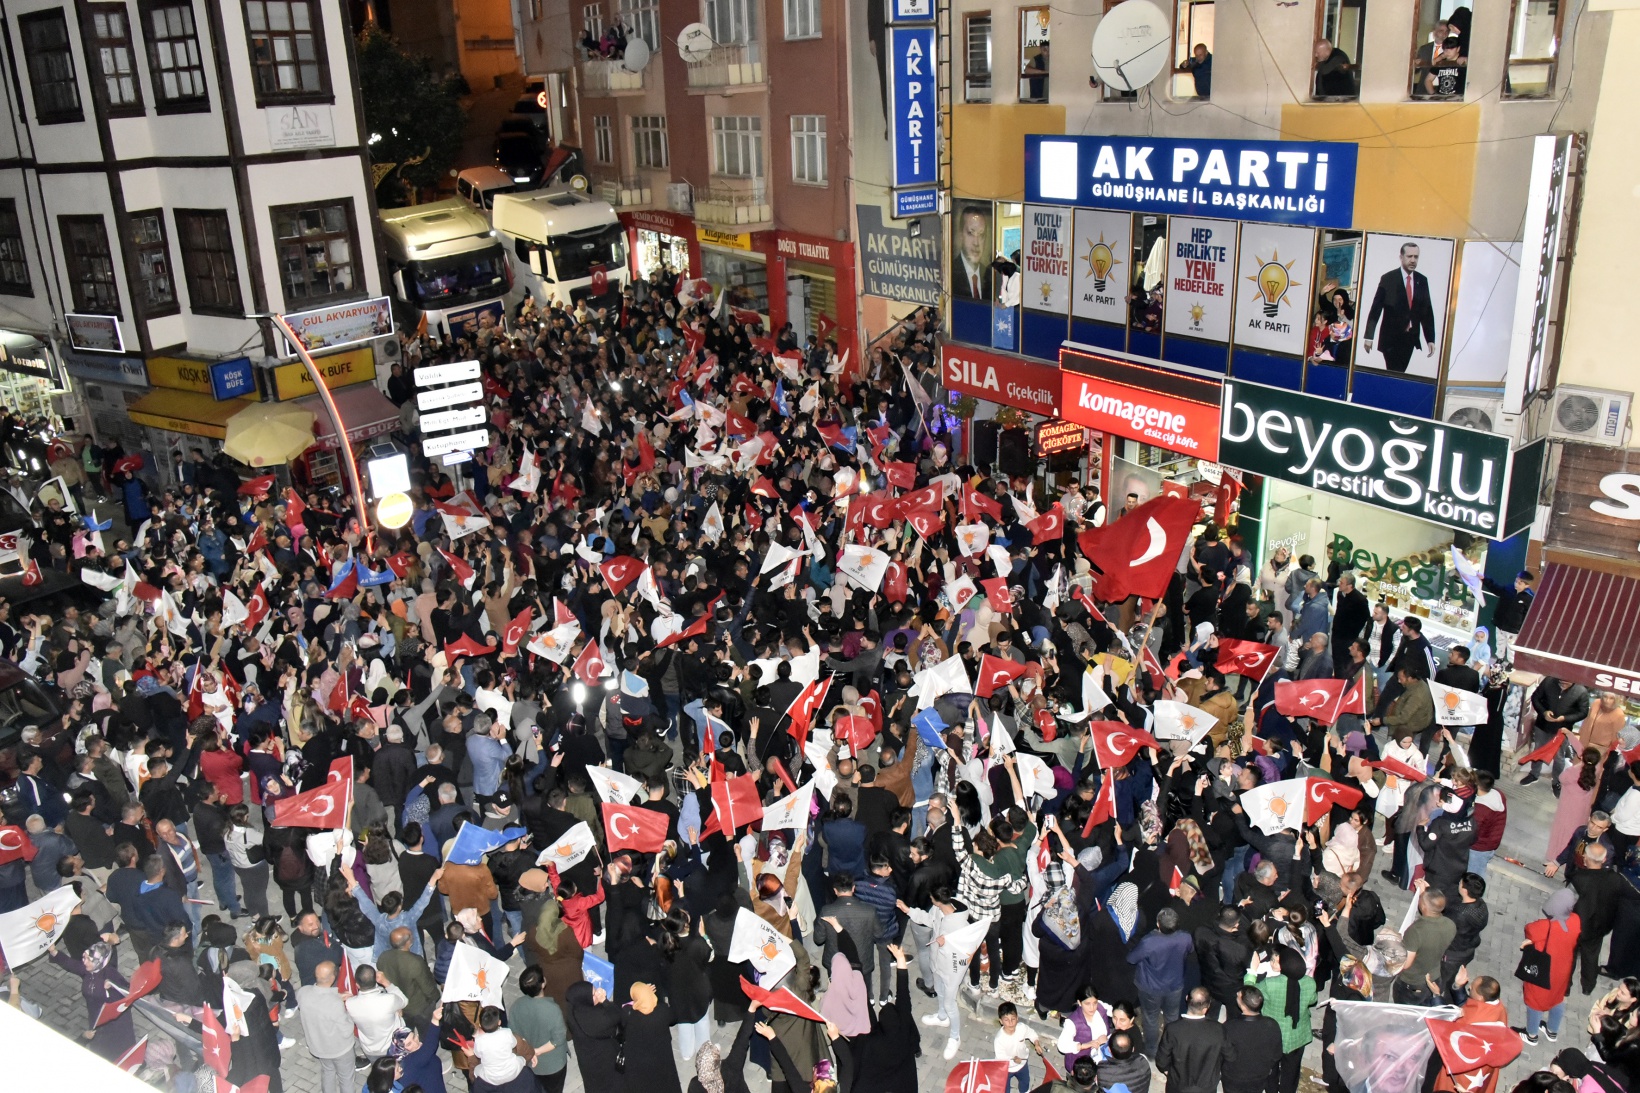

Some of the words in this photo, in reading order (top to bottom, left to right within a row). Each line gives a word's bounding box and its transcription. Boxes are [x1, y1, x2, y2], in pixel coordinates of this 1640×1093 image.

[1092, 145, 1154, 181] AK
[1092, 182, 1188, 203] GÜMÜŞHANE
[1192, 186, 1208, 204] İL
[1212, 191, 1325, 213] BAŞKANLIĞI
[1034, 212, 1062, 228] KUTLU
[1037, 227, 1058, 242] DAVA
[1191, 227, 1213, 244] HEP
[867, 233, 889, 255] AK
[891, 235, 937, 261] PARTİ
[868, 257, 941, 282] GÜMÜŞHANE
[870, 278, 880, 293] İL
[881, 282, 940, 304] BAŞKANLIĞ
[1083, 293, 1093, 302] AK
[1174, 278, 1224, 296] HEDEFLERE
[303, 314, 323, 327] GÜL
[326, 304, 378, 322] AKVARYUM
[1248, 319, 1262, 329] AK
[223, 369, 243, 381] KÖŞK
[327, 361, 353, 377] BÜFE
[226, 378, 245, 389] BÜFE
[948, 357, 1000, 392] SILA
[1006, 382, 1054, 405] Çiçekçilik
[1078, 382, 1186, 433] komagene
[1144, 428, 1162, 440] etsiz
[1162, 432, 1175, 445] çiğ
[1175, 435, 1199, 449] köfte
[1220, 383, 1493, 506] beyoğlu
[1313, 468, 1375, 498] pestil
[1424, 491, 1496, 529] köme
[1332, 532, 1468, 601] Beyoğlu
[1379, 580, 1407, 596] pestil
